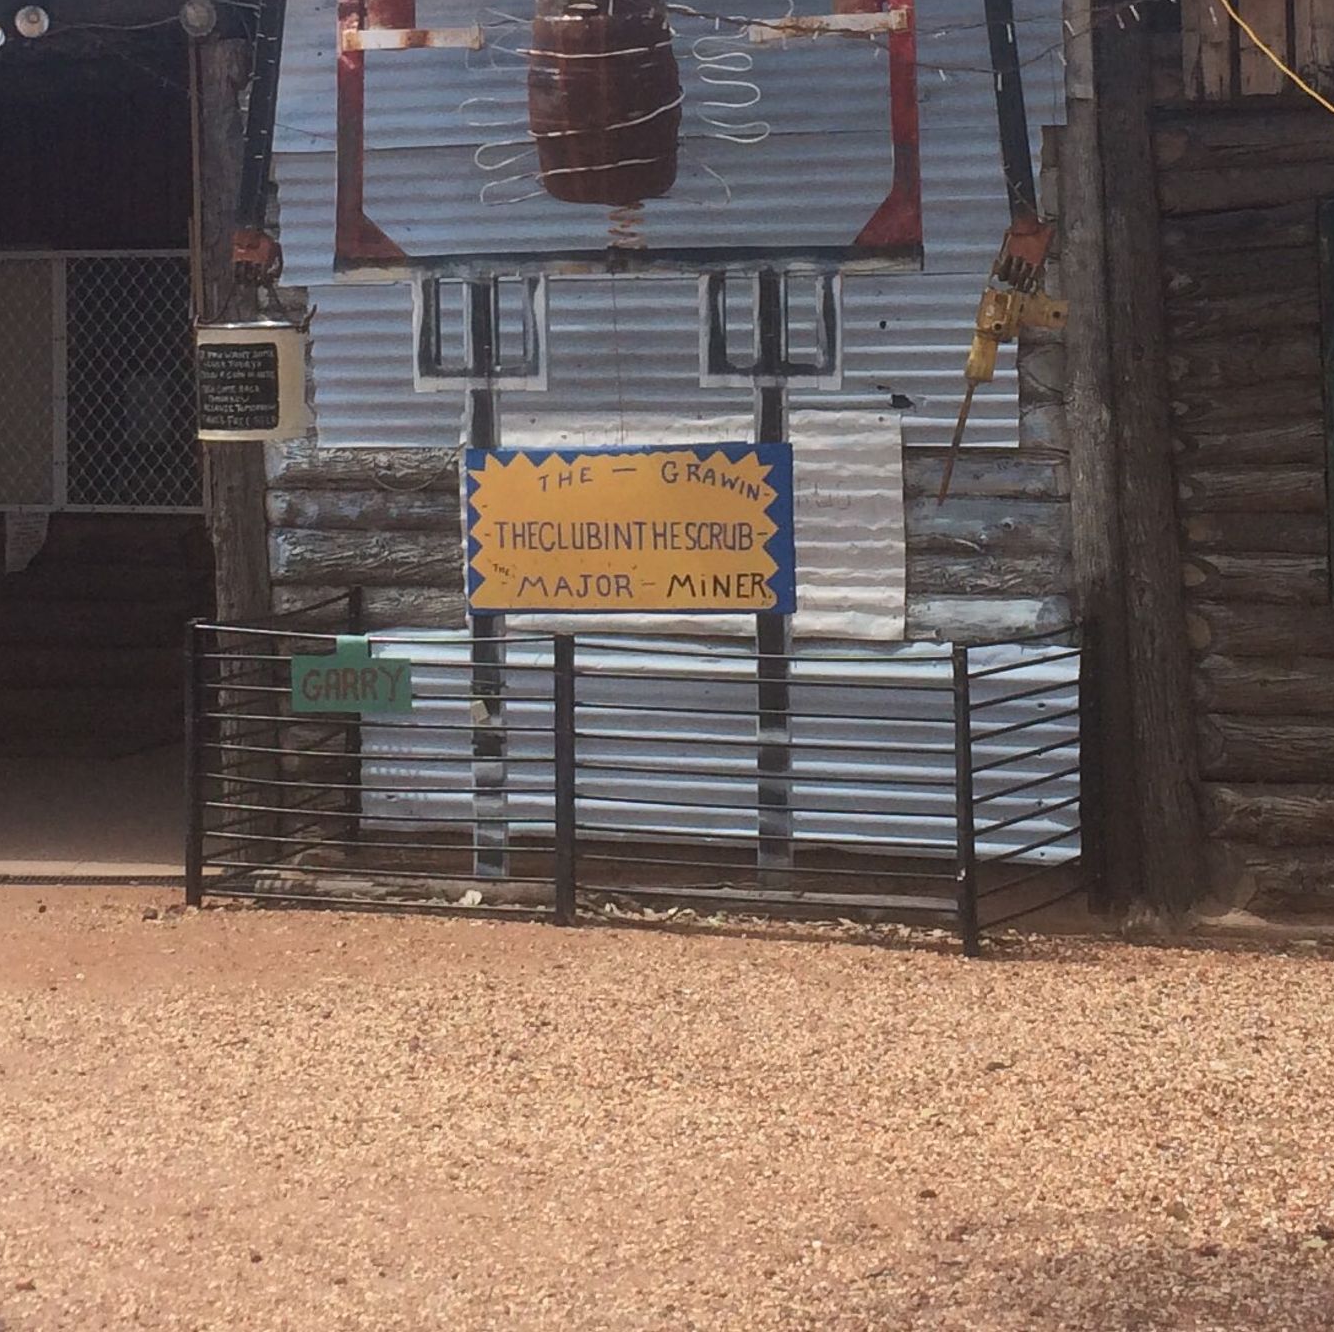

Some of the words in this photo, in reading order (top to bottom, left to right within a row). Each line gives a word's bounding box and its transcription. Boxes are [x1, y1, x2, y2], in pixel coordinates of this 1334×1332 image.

[538, 467, 593, 492] THE
[661, 461, 760, 501] GRAWIN
[494, 521, 754, 552] THECLUBINTHESCRUB
[517, 574, 633, 598] MAJOR
[302, 666, 405, 702] GARRY
